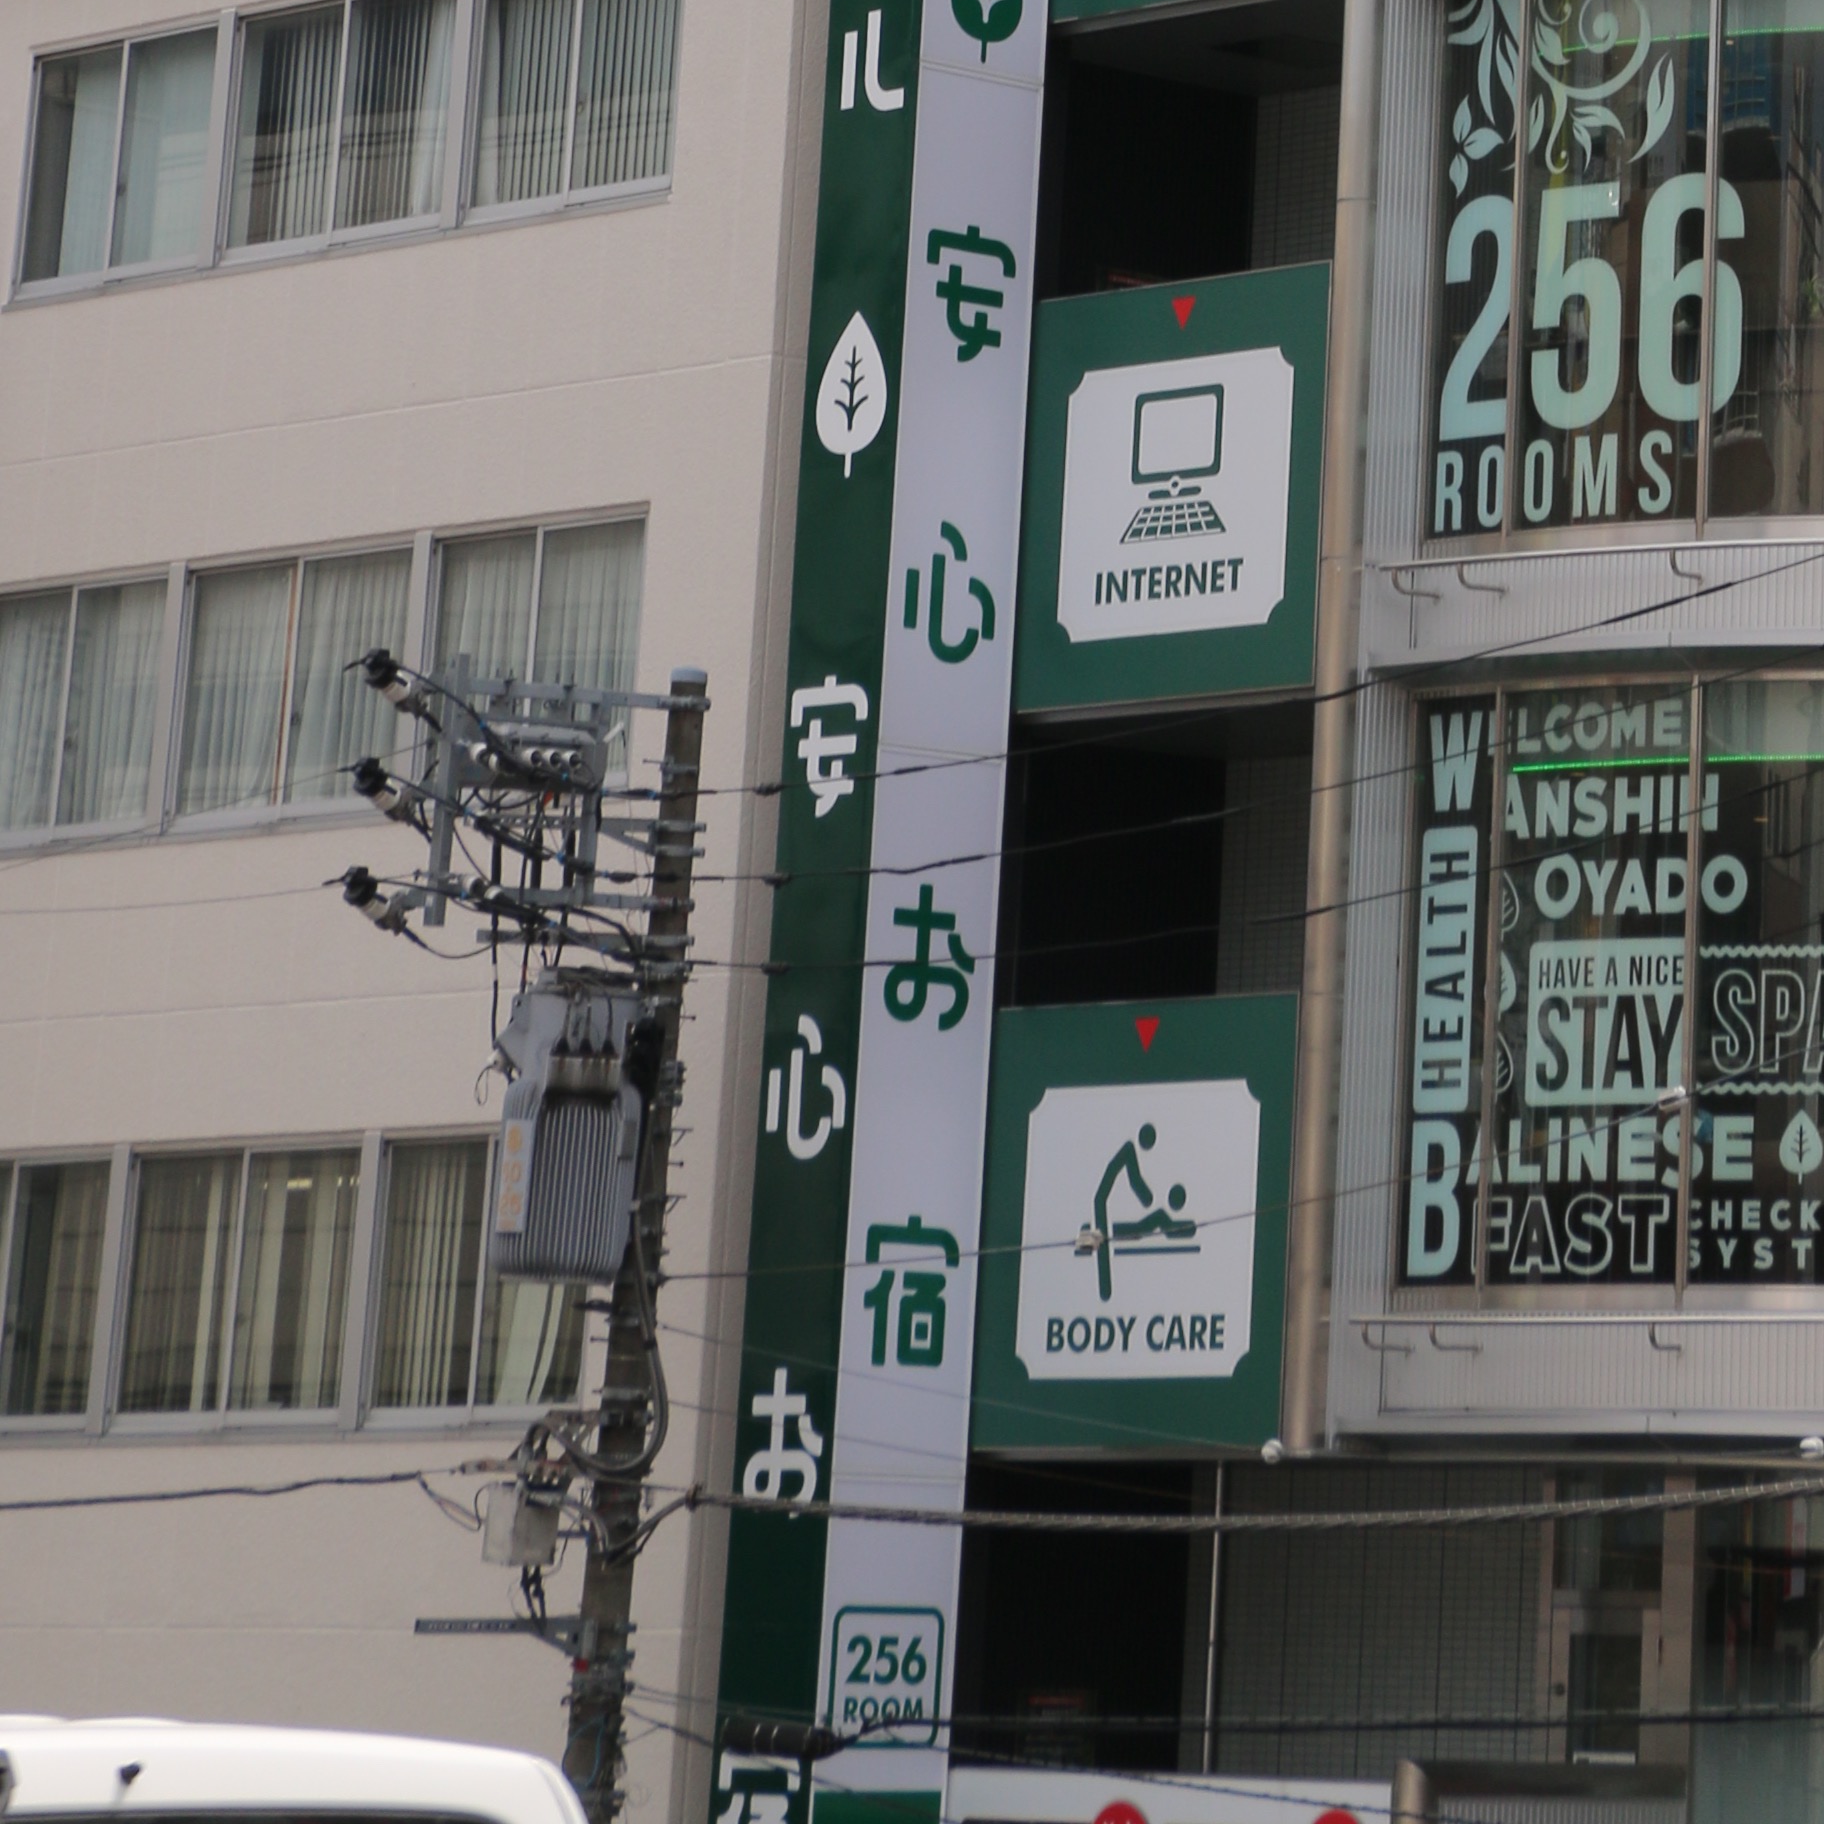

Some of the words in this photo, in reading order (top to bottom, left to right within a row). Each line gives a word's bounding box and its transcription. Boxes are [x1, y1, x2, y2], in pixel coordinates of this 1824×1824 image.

[1439, 171, 1746, 441] 256
[1433, 429, 1673, 534] ROOMS
[1094, 556, 1245, 607] INTERNET
[863, 224, 1017, 1368] 安心お宿
[1503, 773, 1721, 841] ANSHIN
[1533, 852, 1749, 920] OYADO
[1422, 849, 1472, 1092] HEALTH
[1538, 956, 1596, 990] HAVE
[1604, 955, 1619, 987] A
[1628, 954, 1684, 987] NICE
[1534, 993, 1685, 1092] STAY
[1470, 1192, 1671, 1276] FAST
[1045, 1314, 1138, 1354] BODY
[1145, 1312, 1227, 1353] CARE
[845, 1633, 928, 1687] 256
[842, 1695, 925, 1725] ROOM
